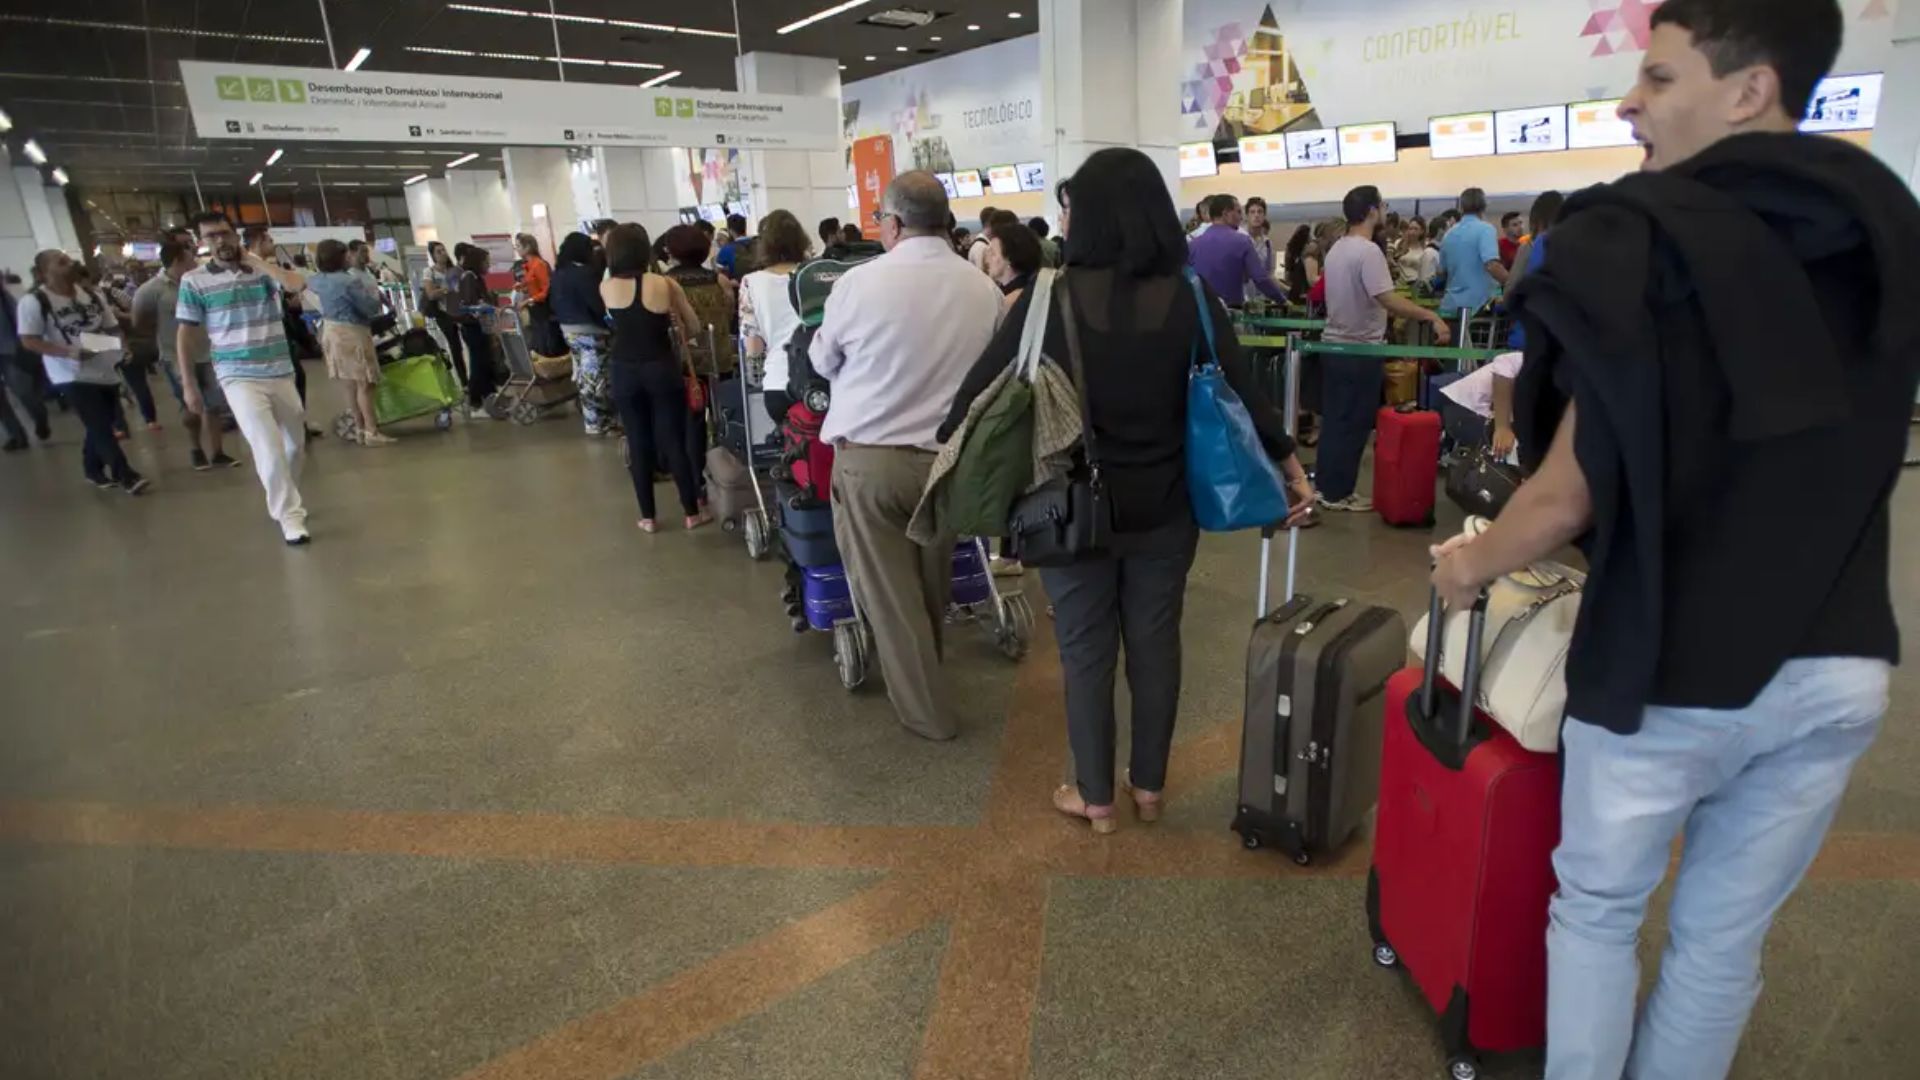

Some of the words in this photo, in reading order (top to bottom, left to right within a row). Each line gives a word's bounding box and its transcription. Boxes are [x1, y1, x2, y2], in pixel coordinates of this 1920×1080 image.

[1363, 9, 1521, 62] CONFORTÁVEL
[308, 82, 383, 96] Desembarque
[442, 88, 503, 100] Internacional
[962, 99, 1033, 129] TECNOLÓGICO
